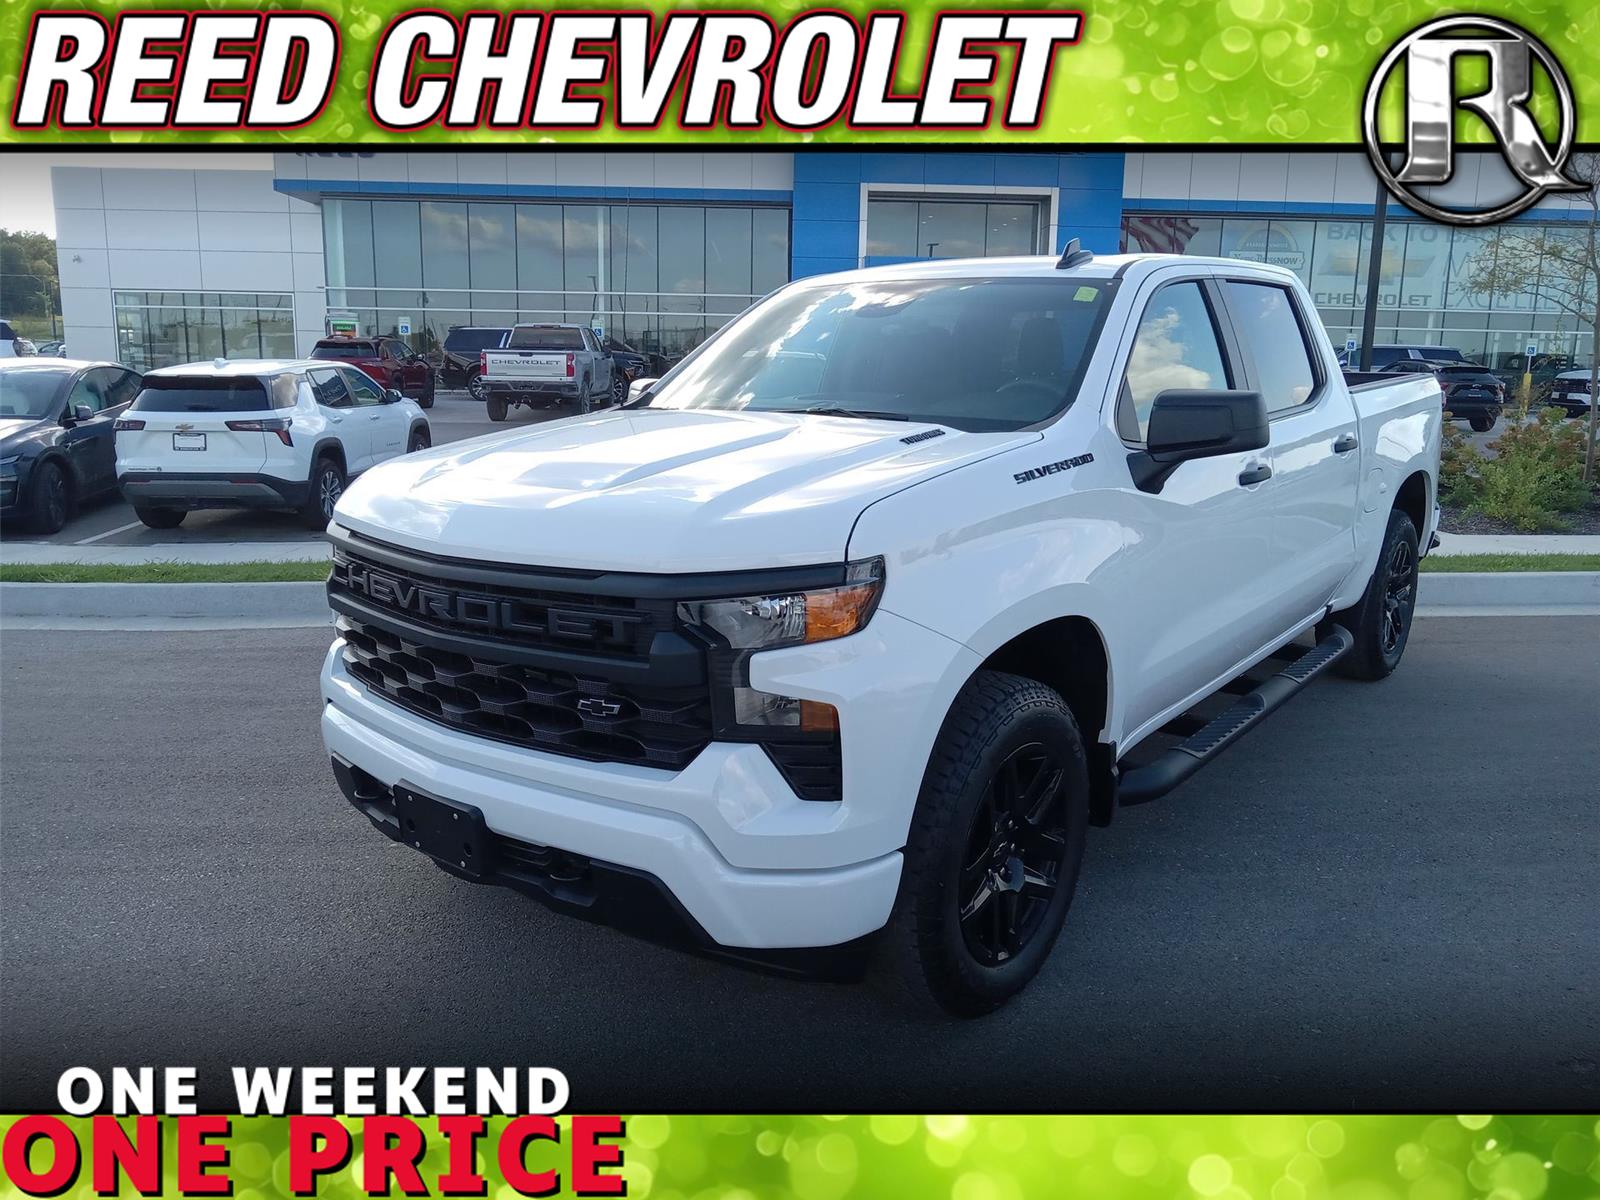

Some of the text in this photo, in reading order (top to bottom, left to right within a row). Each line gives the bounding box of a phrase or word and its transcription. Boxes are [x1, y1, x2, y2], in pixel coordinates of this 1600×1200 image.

[1314, 292, 1432, 306] CHEVOLET
[1013, 452, 1094, 485] SILVERADO
[332, 556, 655, 643] CHEVROLET
